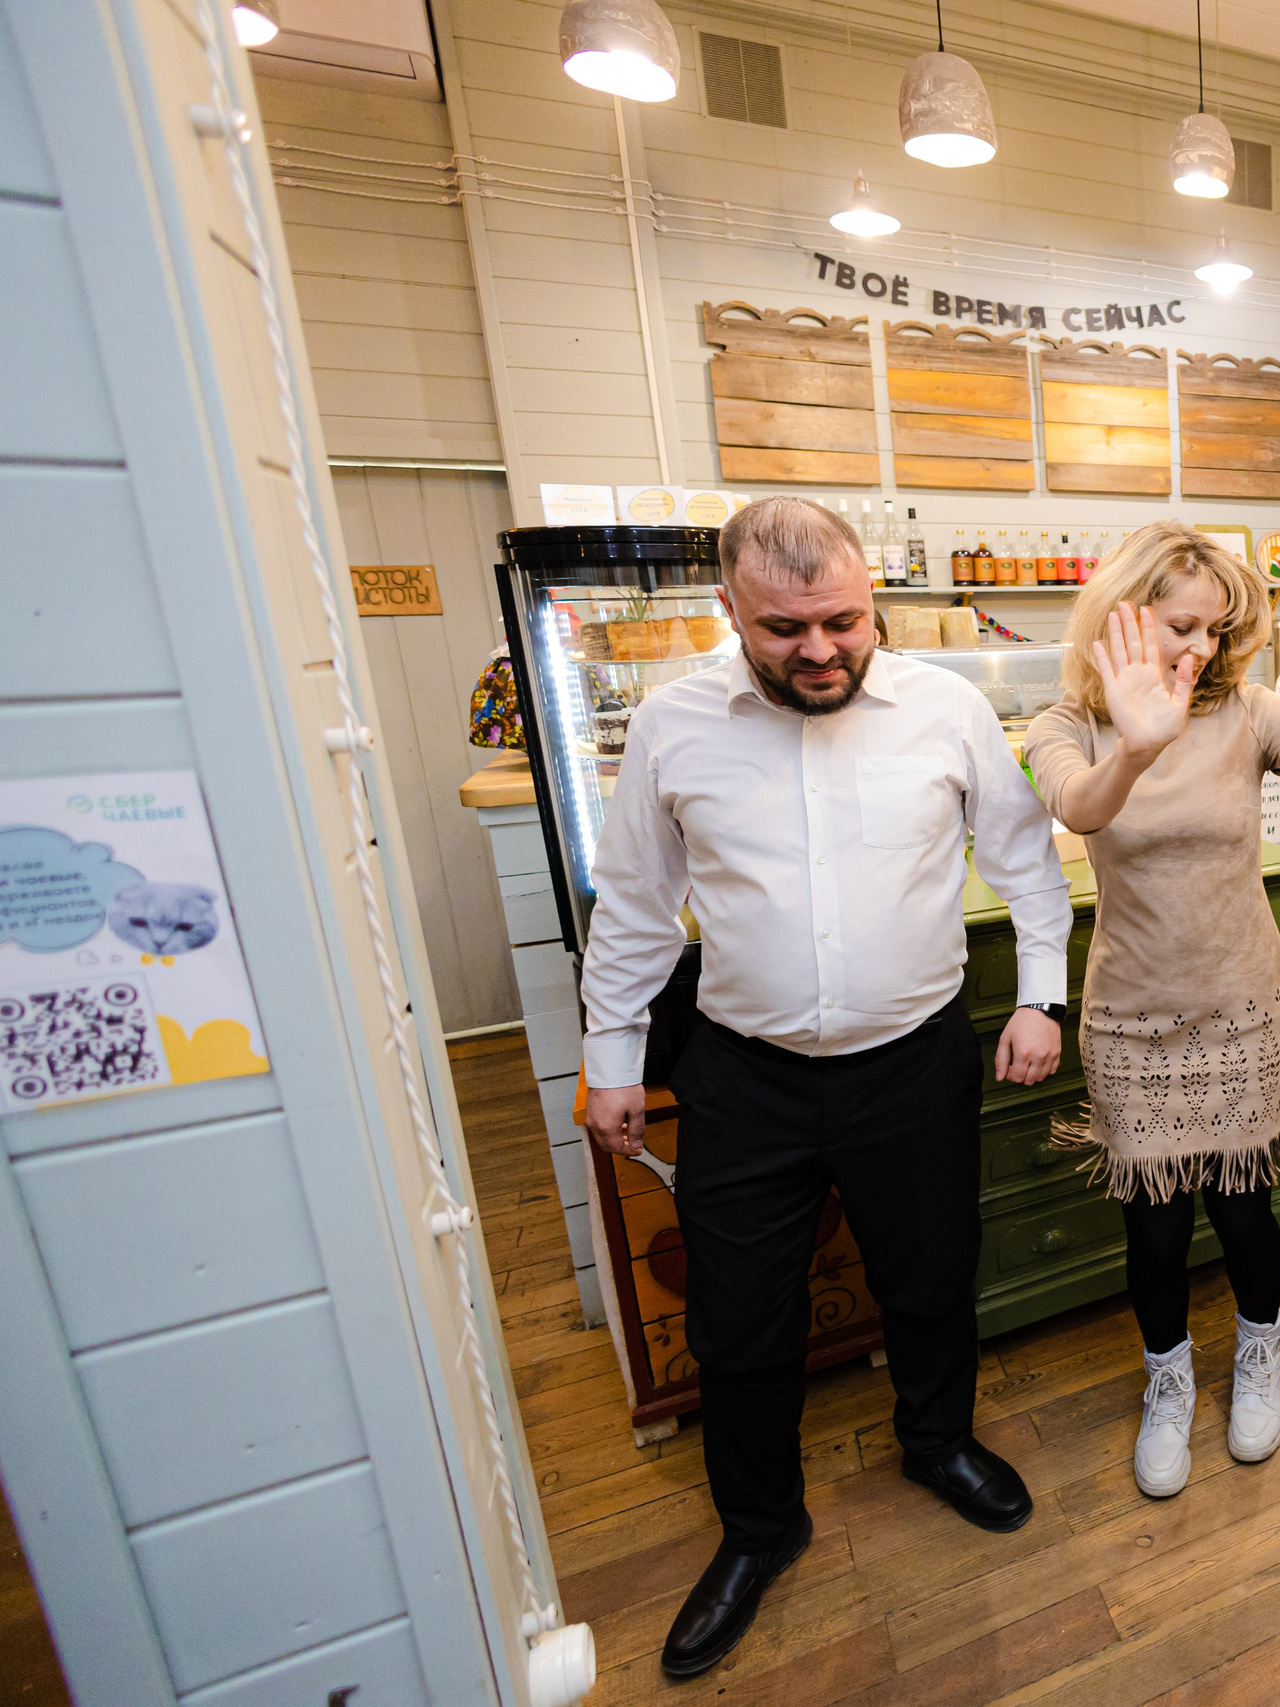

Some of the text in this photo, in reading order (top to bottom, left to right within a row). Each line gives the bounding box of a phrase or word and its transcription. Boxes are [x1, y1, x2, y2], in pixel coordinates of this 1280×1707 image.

[814, 252, 1186, 332] ТВОЁ ВРЕМЯ СЕЙЧАС
[355, 586, 430, 605] ИСТОТЫ
[99, 793, 156, 809] СБЕР
[102, 806, 187, 822] ЧАЕВЫЕ
